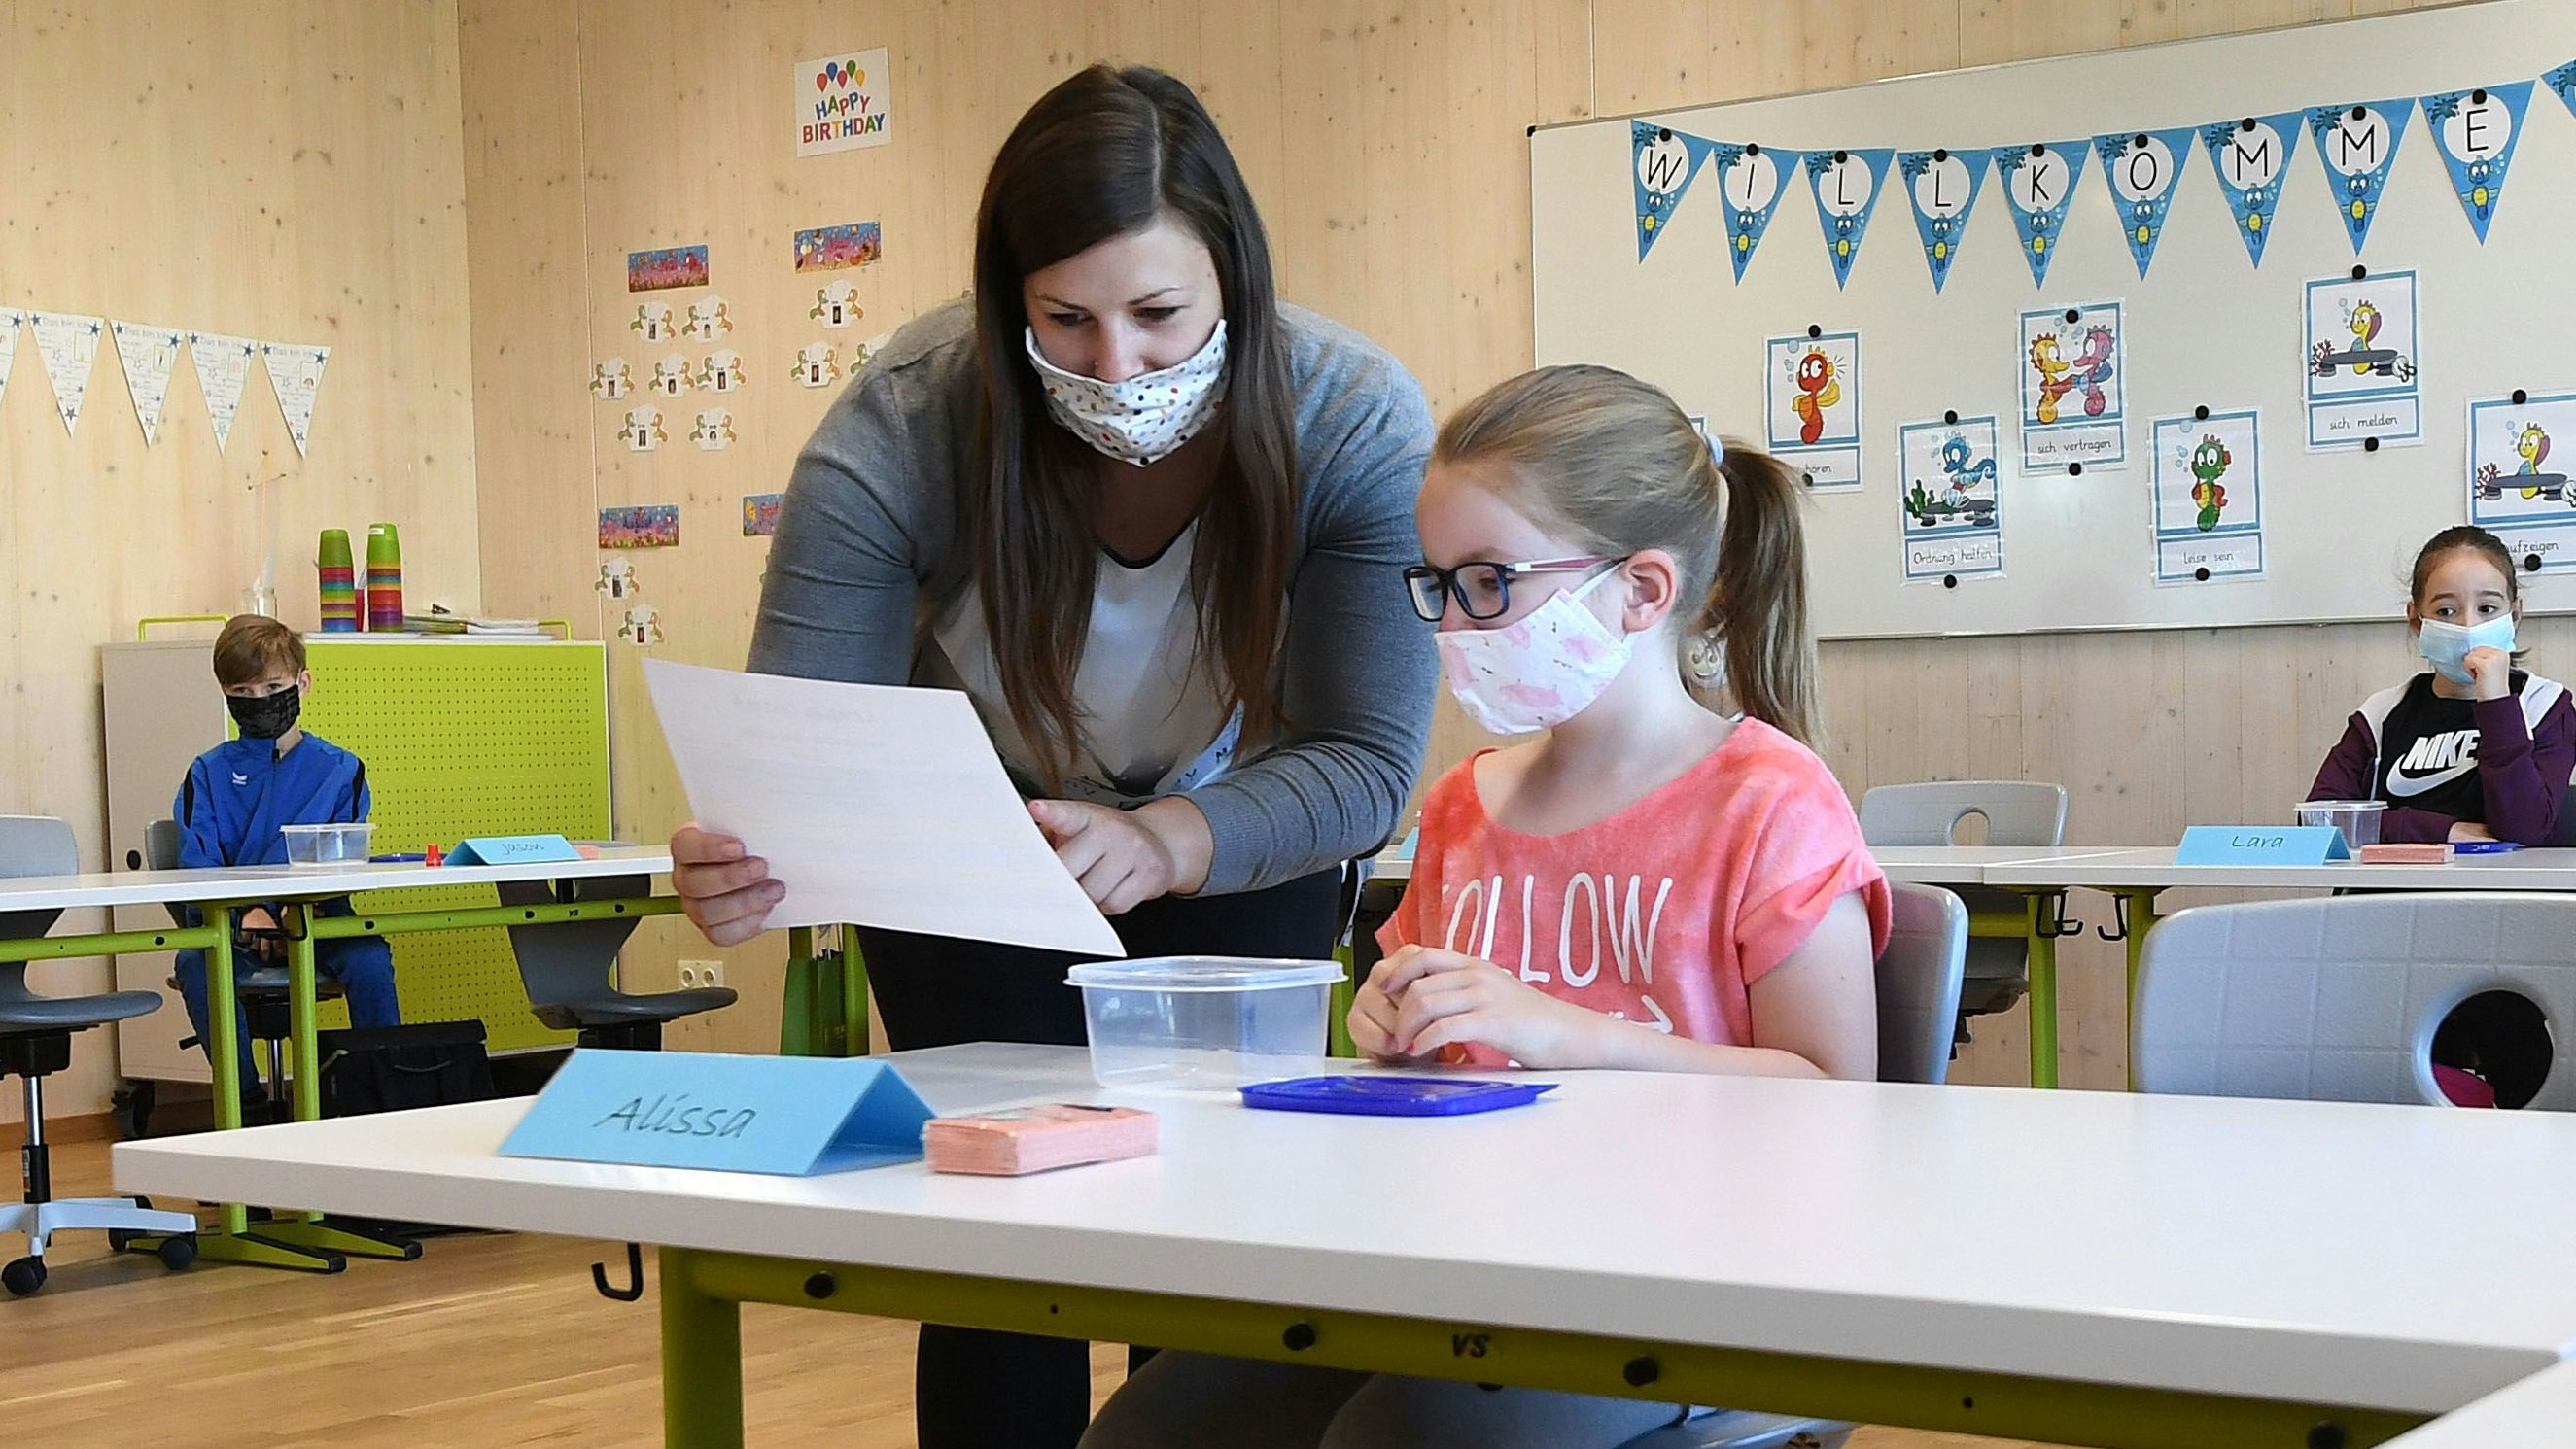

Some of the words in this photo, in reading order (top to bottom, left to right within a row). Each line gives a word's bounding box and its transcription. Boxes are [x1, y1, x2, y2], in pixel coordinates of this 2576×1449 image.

[815, 91, 871, 121] HAPPY
[802, 112, 886, 144] BIRTHDAY
[2357, 413, 2398, 428] melden
[2063, 438, 2111, 454] vertragen
[1913, 550, 1955, 566] Ordnung
[2508, 539, 2559, 556] ufzeigen
[2400, 729, 2481, 770] NIKE
[2231, 835, 2284, 848] Lara
[1442, 872, 1673, 987] OLLOW
[592, 1093, 758, 1139] Alissa
[1451, 1331, 1492, 1359] VS
